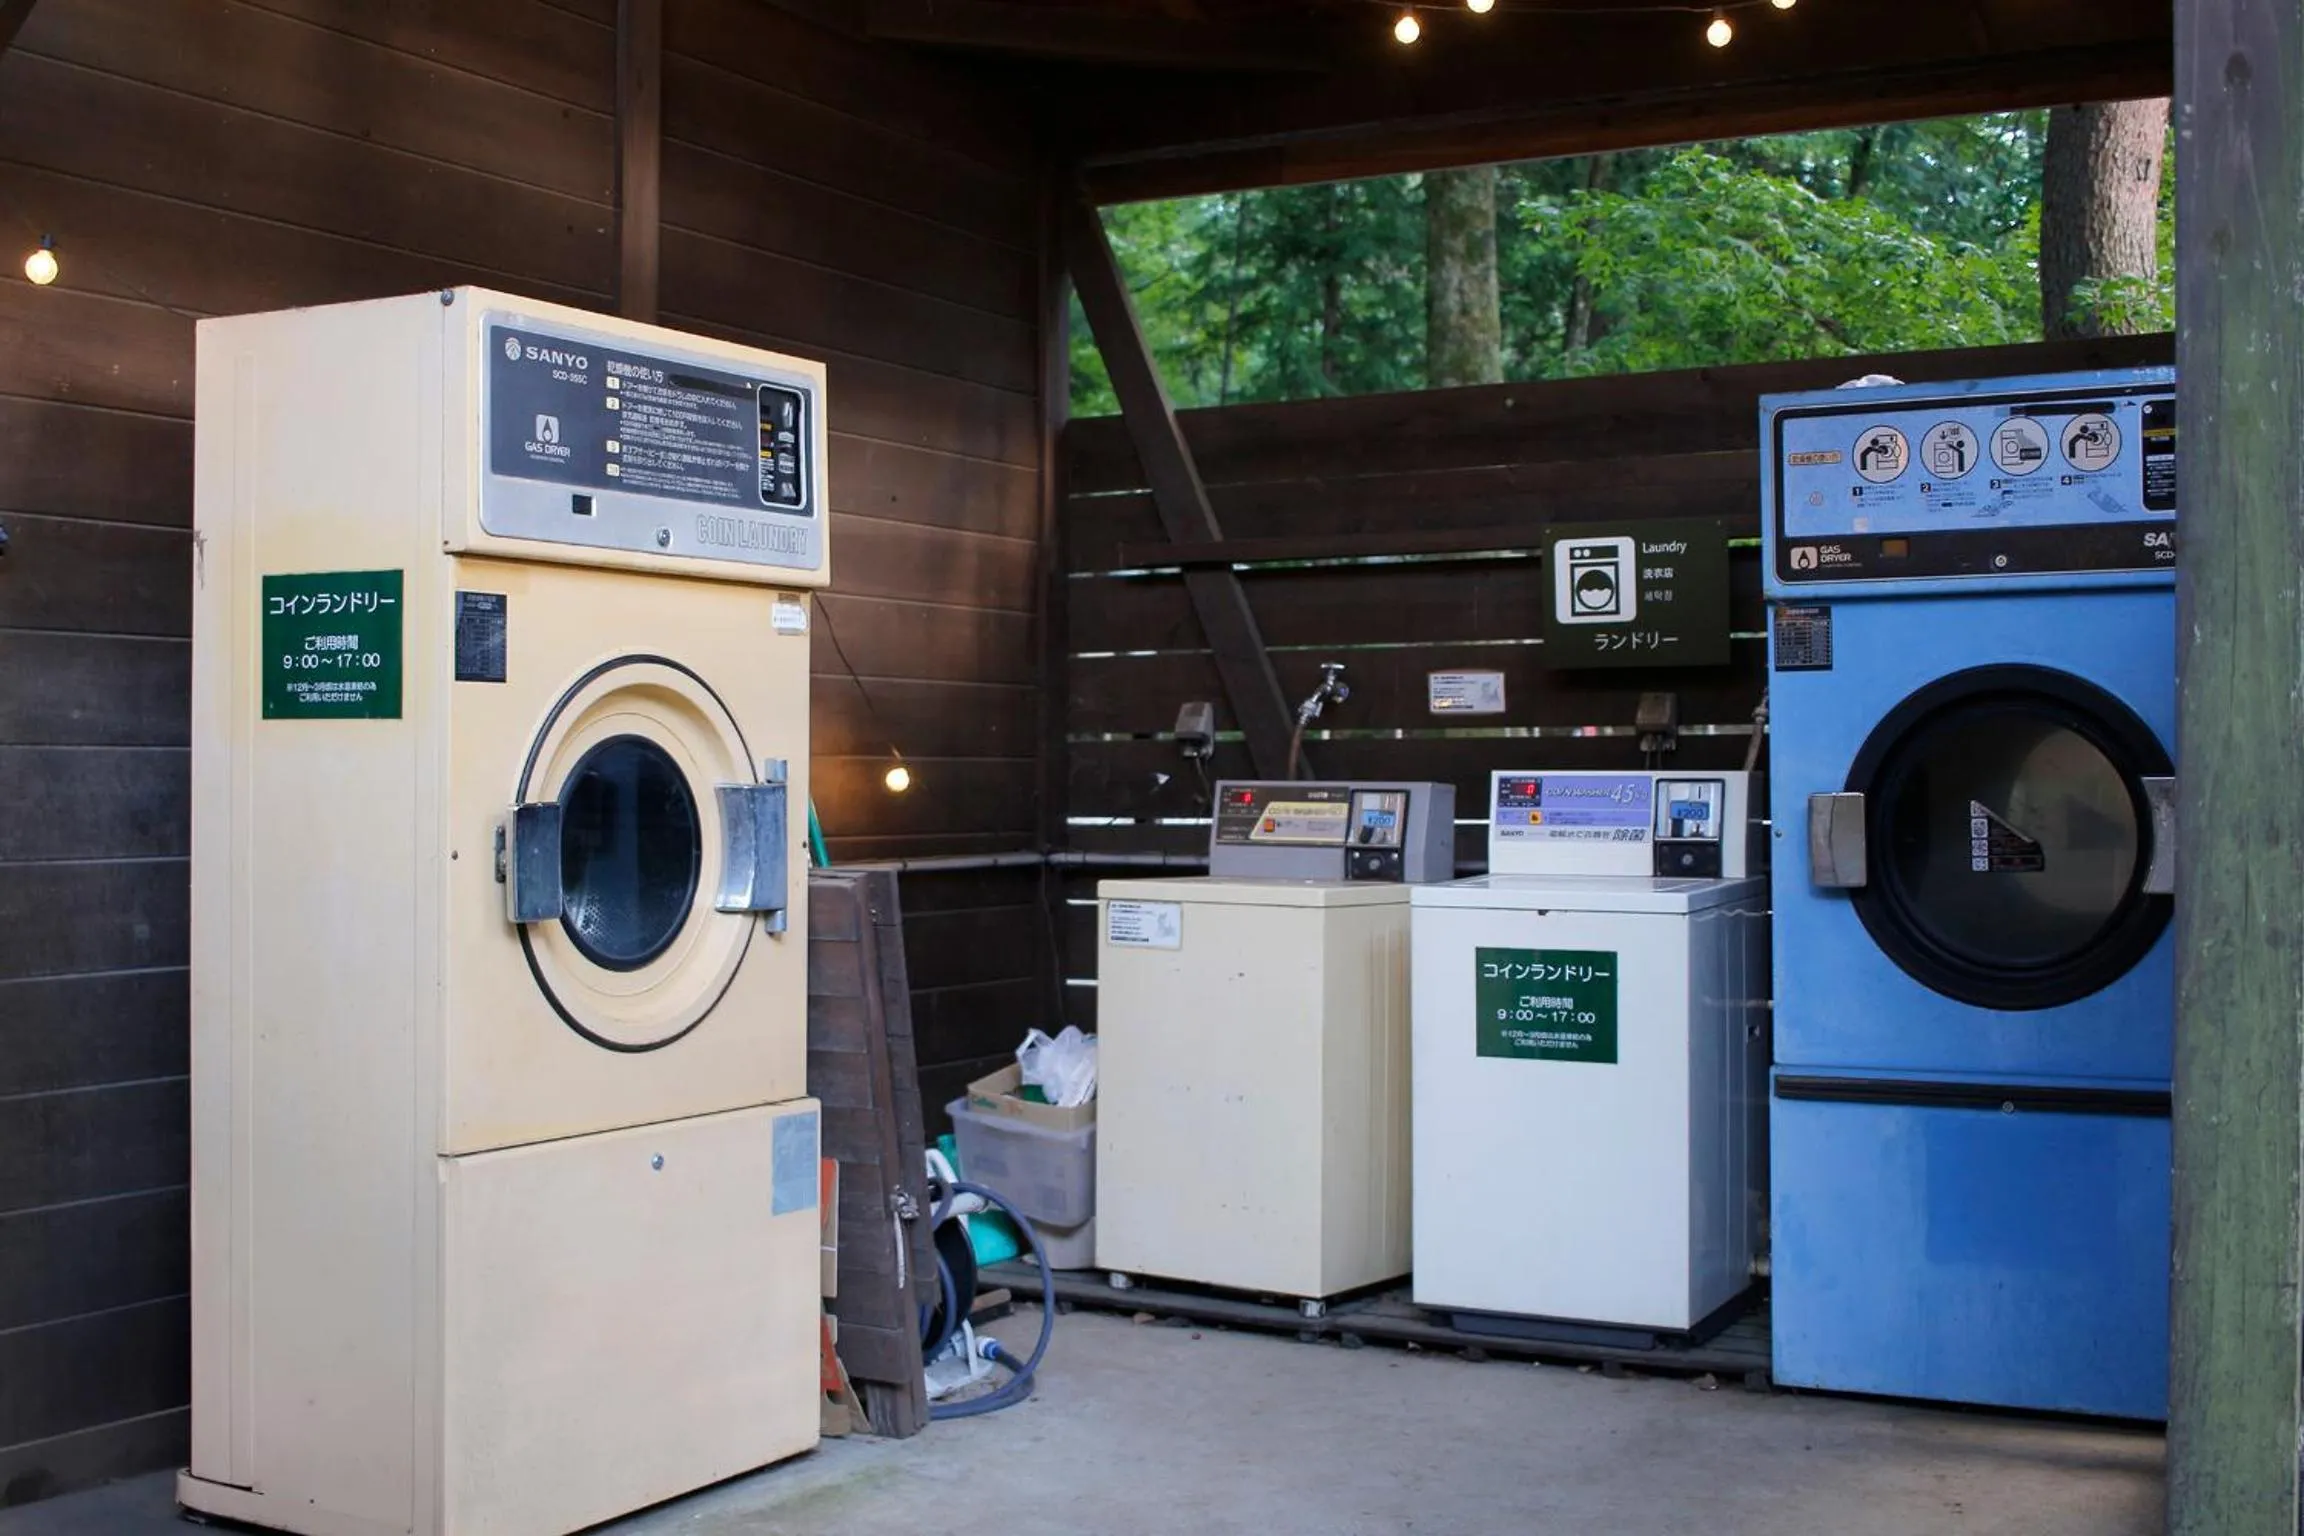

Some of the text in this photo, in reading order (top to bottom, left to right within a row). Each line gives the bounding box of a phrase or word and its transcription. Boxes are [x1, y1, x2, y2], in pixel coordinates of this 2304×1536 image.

[526, 346, 589, 370] SANYO
[525, 441, 571, 458] GAS DRYER
[696, 513, 809, 556] COIN LAUNDRY
[1642, 540, 1688, 555] Laundry
[1820, 545, 1841, 554] GAS
[1820, 553, 1852, 563] DRYER
[269, 591, 396, 615] コインランドリー
[304, 634, 359, 650] ご利用時間
[1594, 631, 1679, 651] ランドリー
[1483, 963, 1610, 982] コインランドリー
[1519, 996, 1574, 1010] ご利用時間
